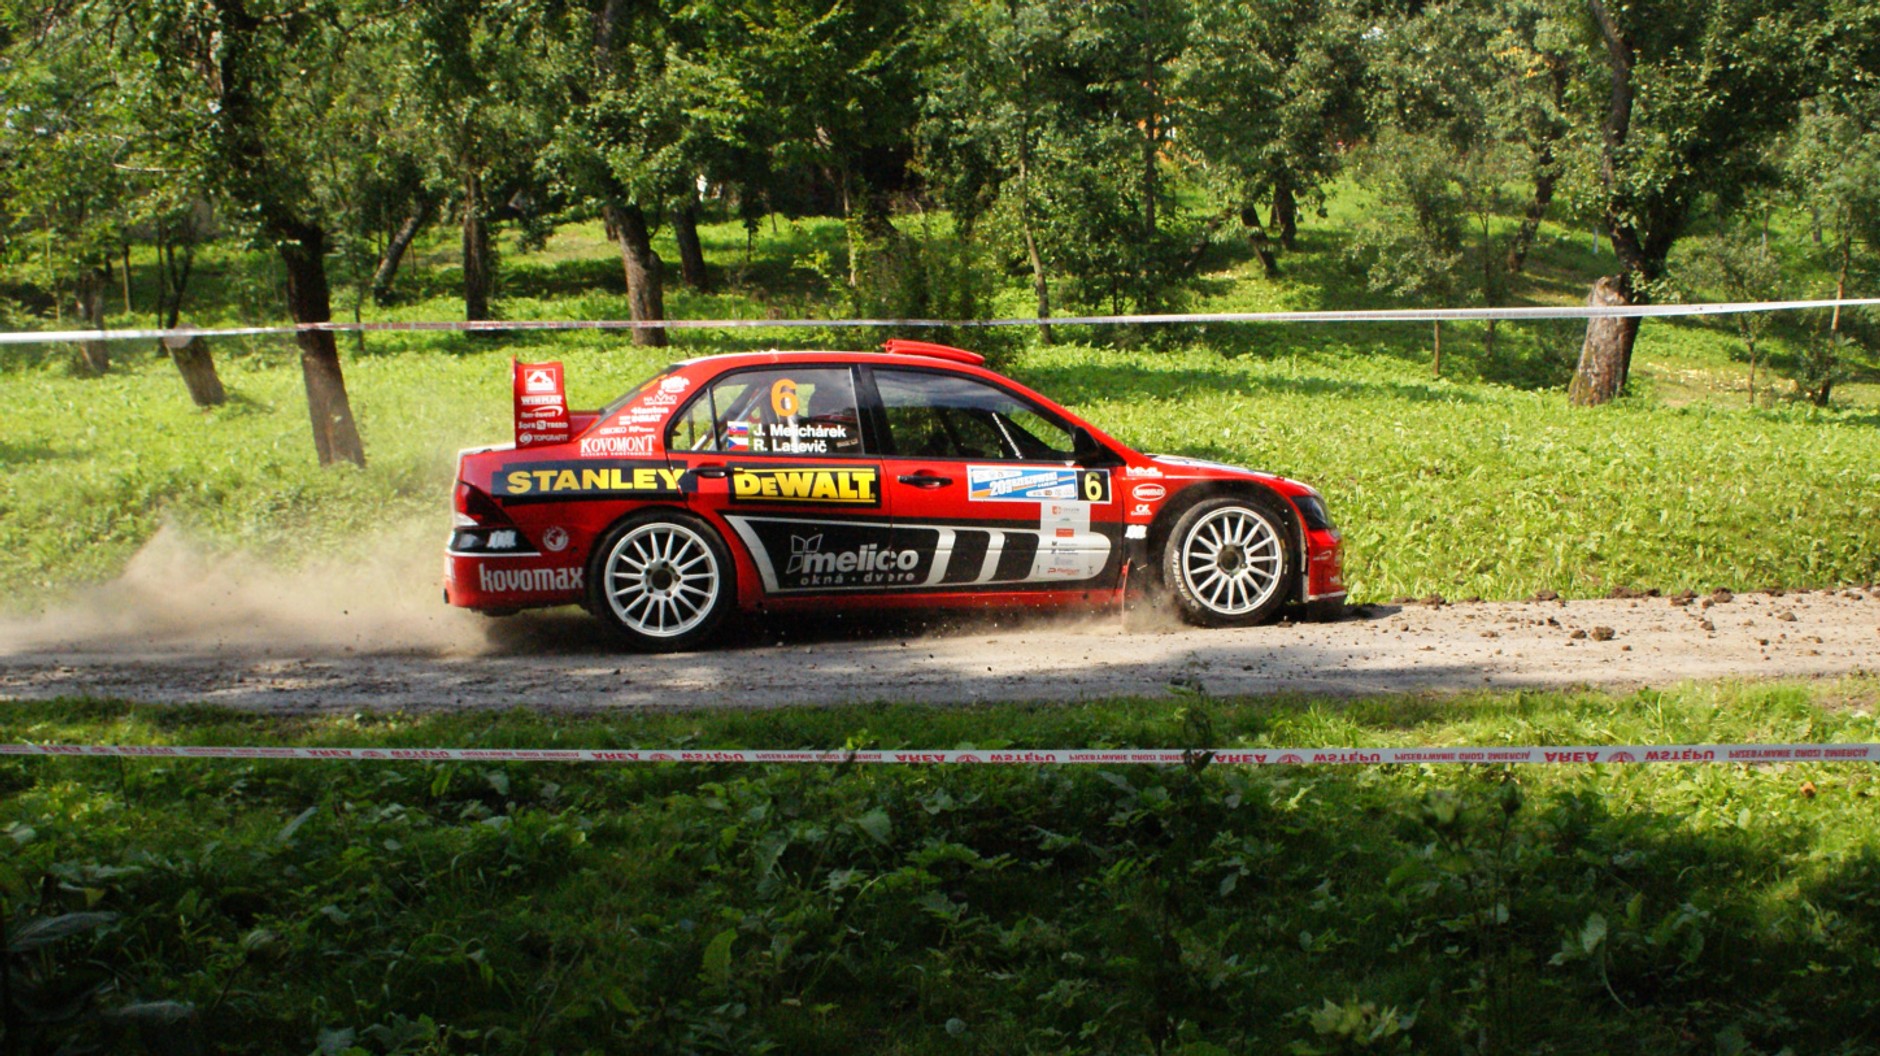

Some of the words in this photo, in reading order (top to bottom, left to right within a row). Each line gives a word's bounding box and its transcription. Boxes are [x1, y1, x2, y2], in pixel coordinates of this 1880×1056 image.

[771, 378, 799, 417] 6
[753, 424, 766, 437] J.
[581, 436, 656, 453] KOVOMONT
[753, 438, 768, 452] R.
[507, 468, 690, 495] STANLEY
[1084, 471, 1103, 501] 6
[802, 543, 919, 573] melico
[479, 563, 584, 593] kovomax
[801, 573, 843, 585] okná
